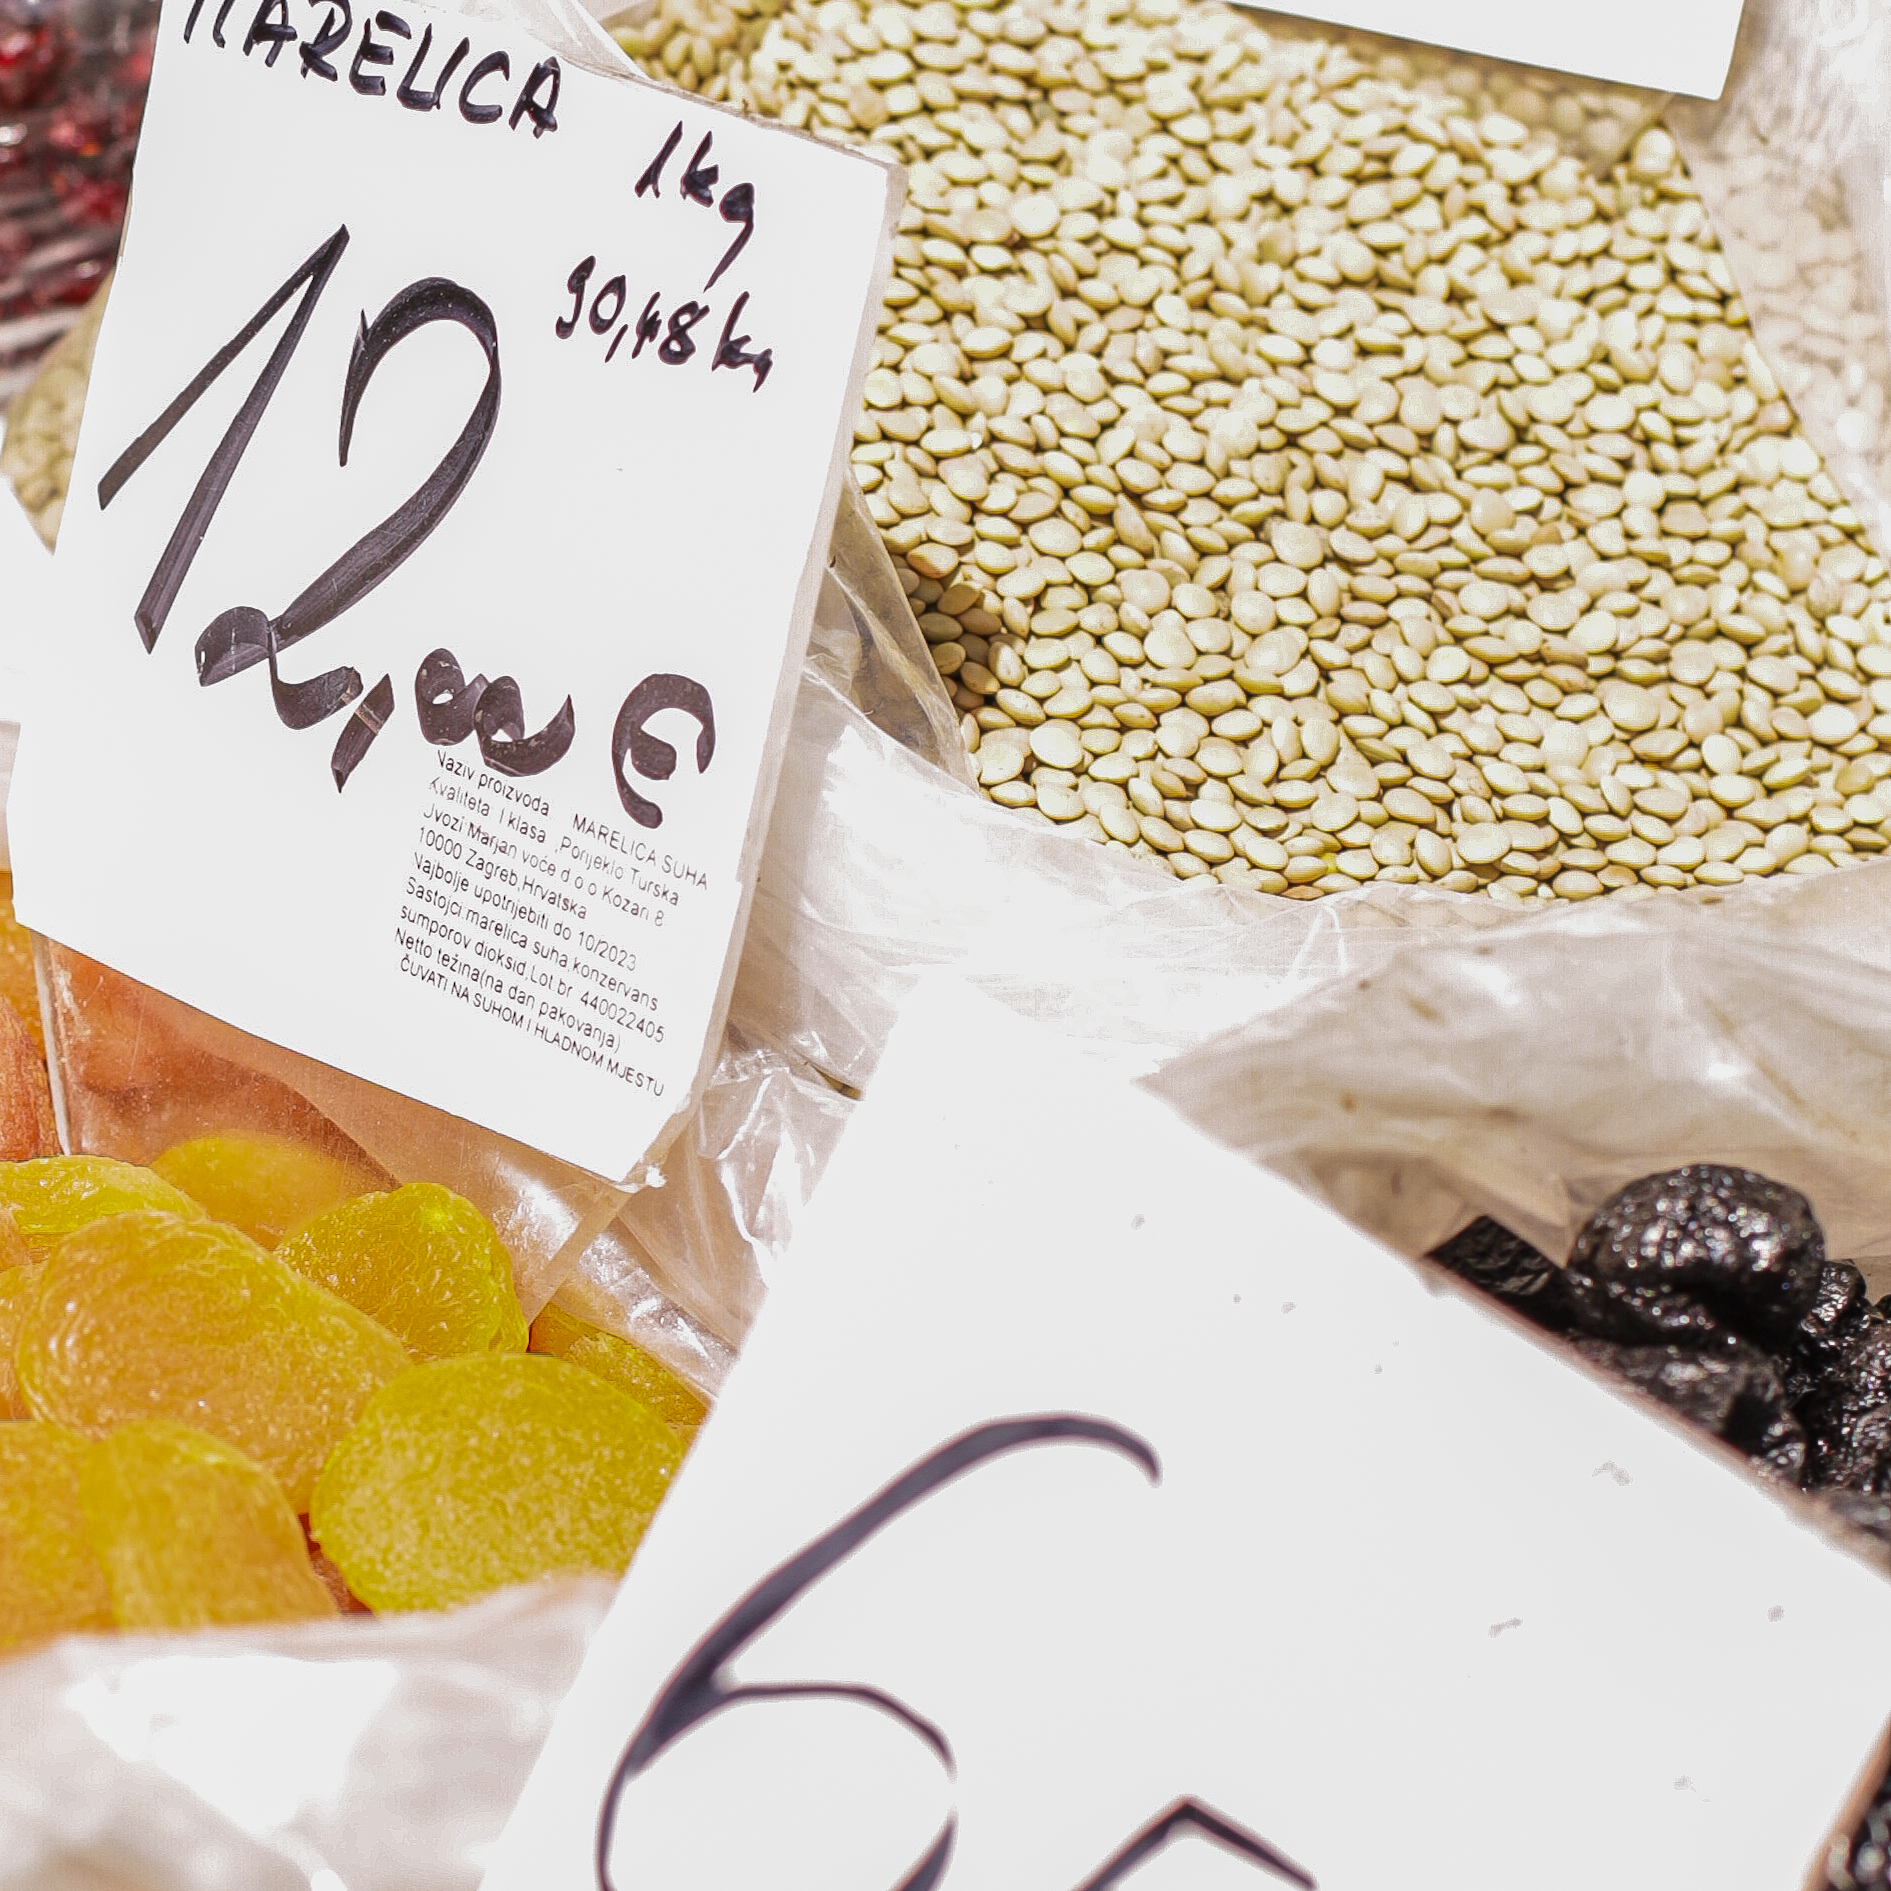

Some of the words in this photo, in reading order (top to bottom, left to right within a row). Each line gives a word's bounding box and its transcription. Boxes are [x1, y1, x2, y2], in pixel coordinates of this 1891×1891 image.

[635, 120, 755, 294] 1kg
[420, 827, 462, 860] 10000
[467, 822, 517, 859] Marjan
[477, 773, 549, 817] proizvoda
[573, 813, 656, 865] MARELICA
[662, 855, 707, 890] SUHA
[499, 808, 505, 823] I
[507, 812, 546, 843] klasa
[631, 867, 679, 906] Turska
[395, 927, 432, 959] Netto
[508, 985, 535, 1009] dan
[400, 905, 471, 949] sumporov
[580, 991, 664, 1043] 440022405
[474, 885, 549, 930] upotrijebiti
[553, 922, 572, 940] do
[579, 931, 636, 971] 10/2023
[400, 953, 448, 991] ČUVATI
[450, 981, 469, 1003] NA
[473, 993, 524, 1028] SUHOM
[526, 1019, 532, 1032] I
[534, 1022, 604, 1068] HLADNOM
[606, 1058, 664, 1097] MJESTU
